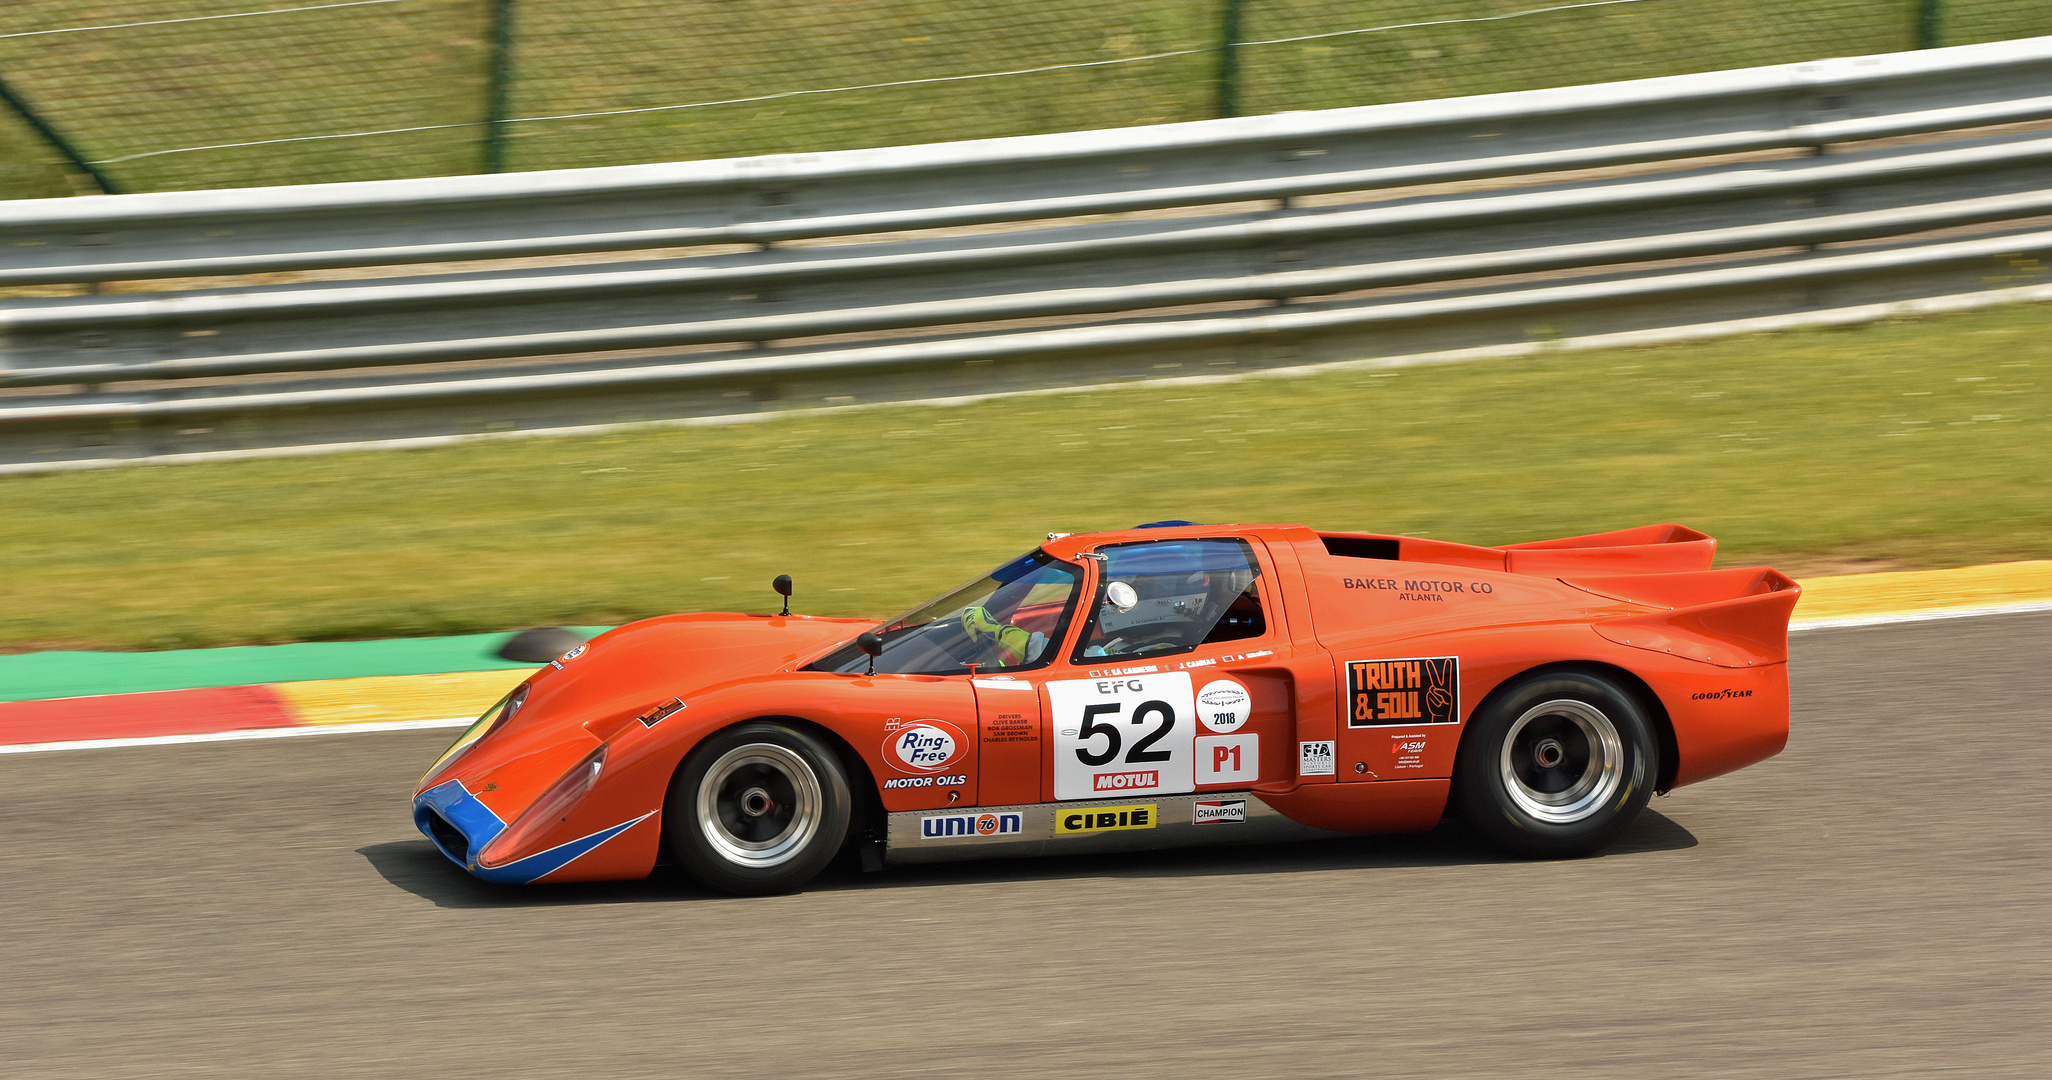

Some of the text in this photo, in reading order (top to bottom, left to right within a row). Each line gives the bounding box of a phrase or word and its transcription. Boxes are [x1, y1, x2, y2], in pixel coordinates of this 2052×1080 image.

[1343, 577, 1493, 594] BAKER MOTOR CO
[1399, 592, 1443, 601] ATLANTA
[1103, 668, 1111, 676] F.
[1353, 661, 1421, 690] TRUTH
[1096, 680, 1143, 694] EFG
[1355, 691, 1421, 720] & SOUL
[1214, 712, 1235, 725] 2018
[1075, 700, 1176, 766] 52
[902, 732, 949, 750] Ring-
[910, 749, 947, 763] Free
[1213, 745, 1241, 773] P1
[884, 775, 966, 789] MOTOR OILS
[1096, 773, 1157, 789] MOTUL
[1064, 808, 1148, 830] CIBIÉ
[1197, 808, 1243, 818] CHAMPION
[980, 819, 994, 829] 76
